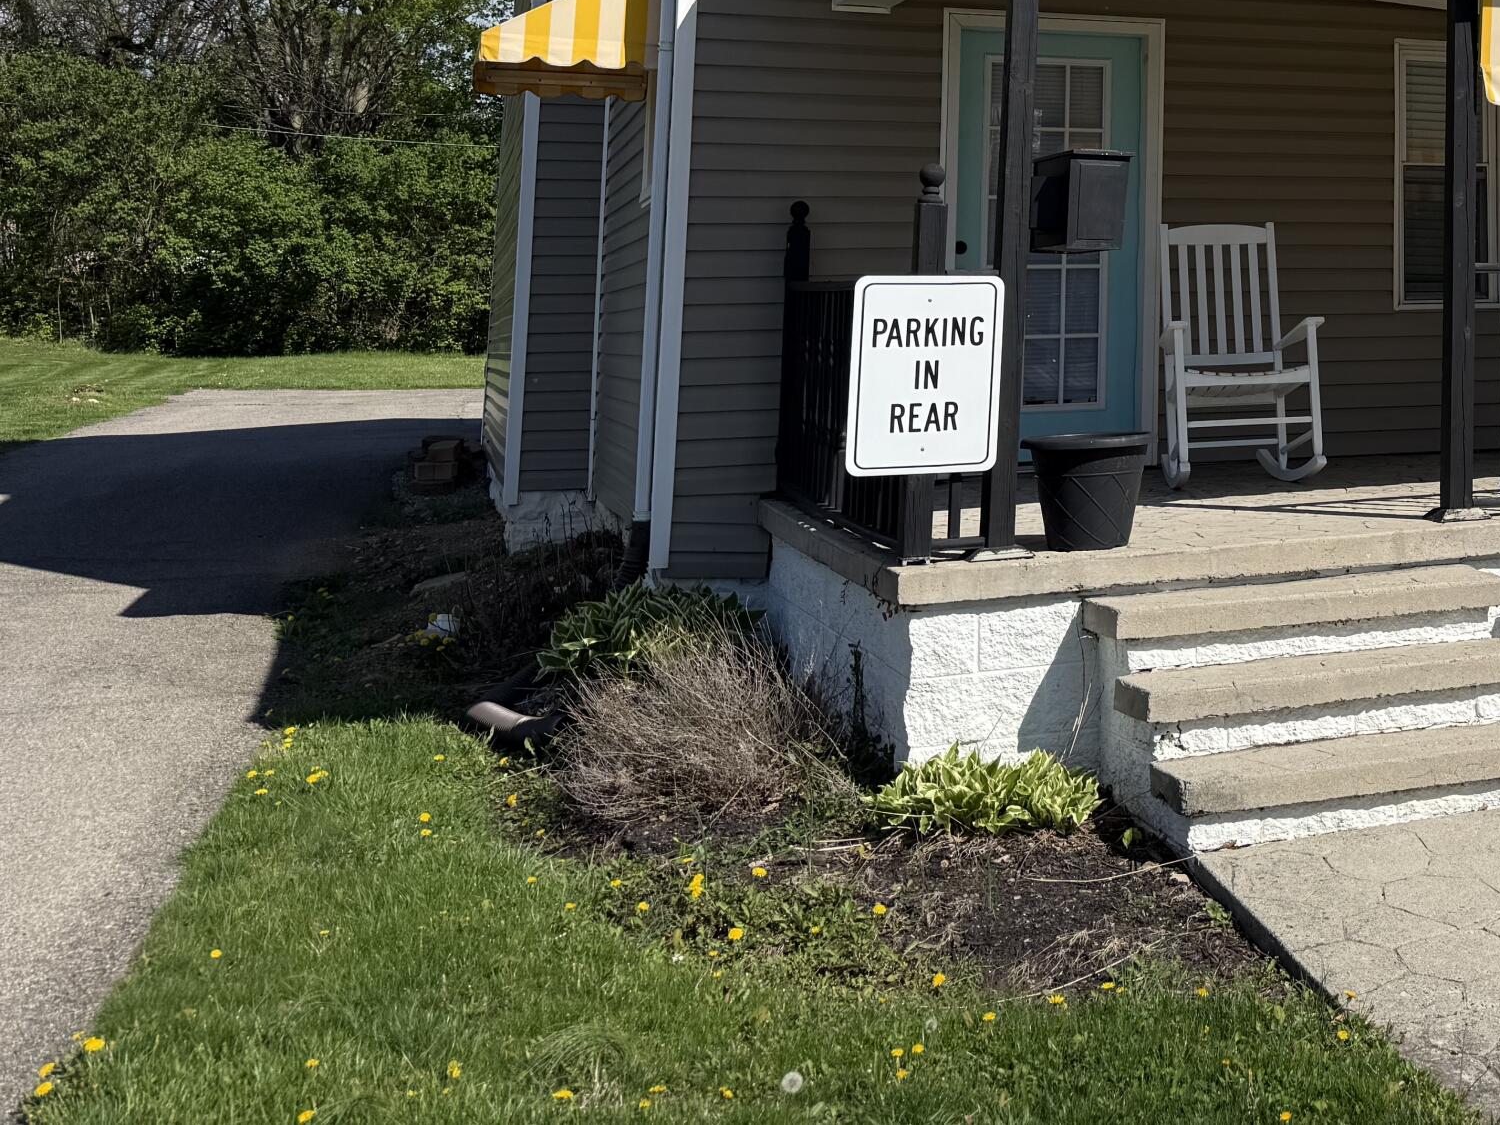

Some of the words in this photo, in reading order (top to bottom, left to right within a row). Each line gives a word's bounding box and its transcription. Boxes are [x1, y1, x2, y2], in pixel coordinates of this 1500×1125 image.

[872, 316, 985, 348] PARKING
[914, 359, 940, 390] IN
[889, 401, 959, 434] REAR
